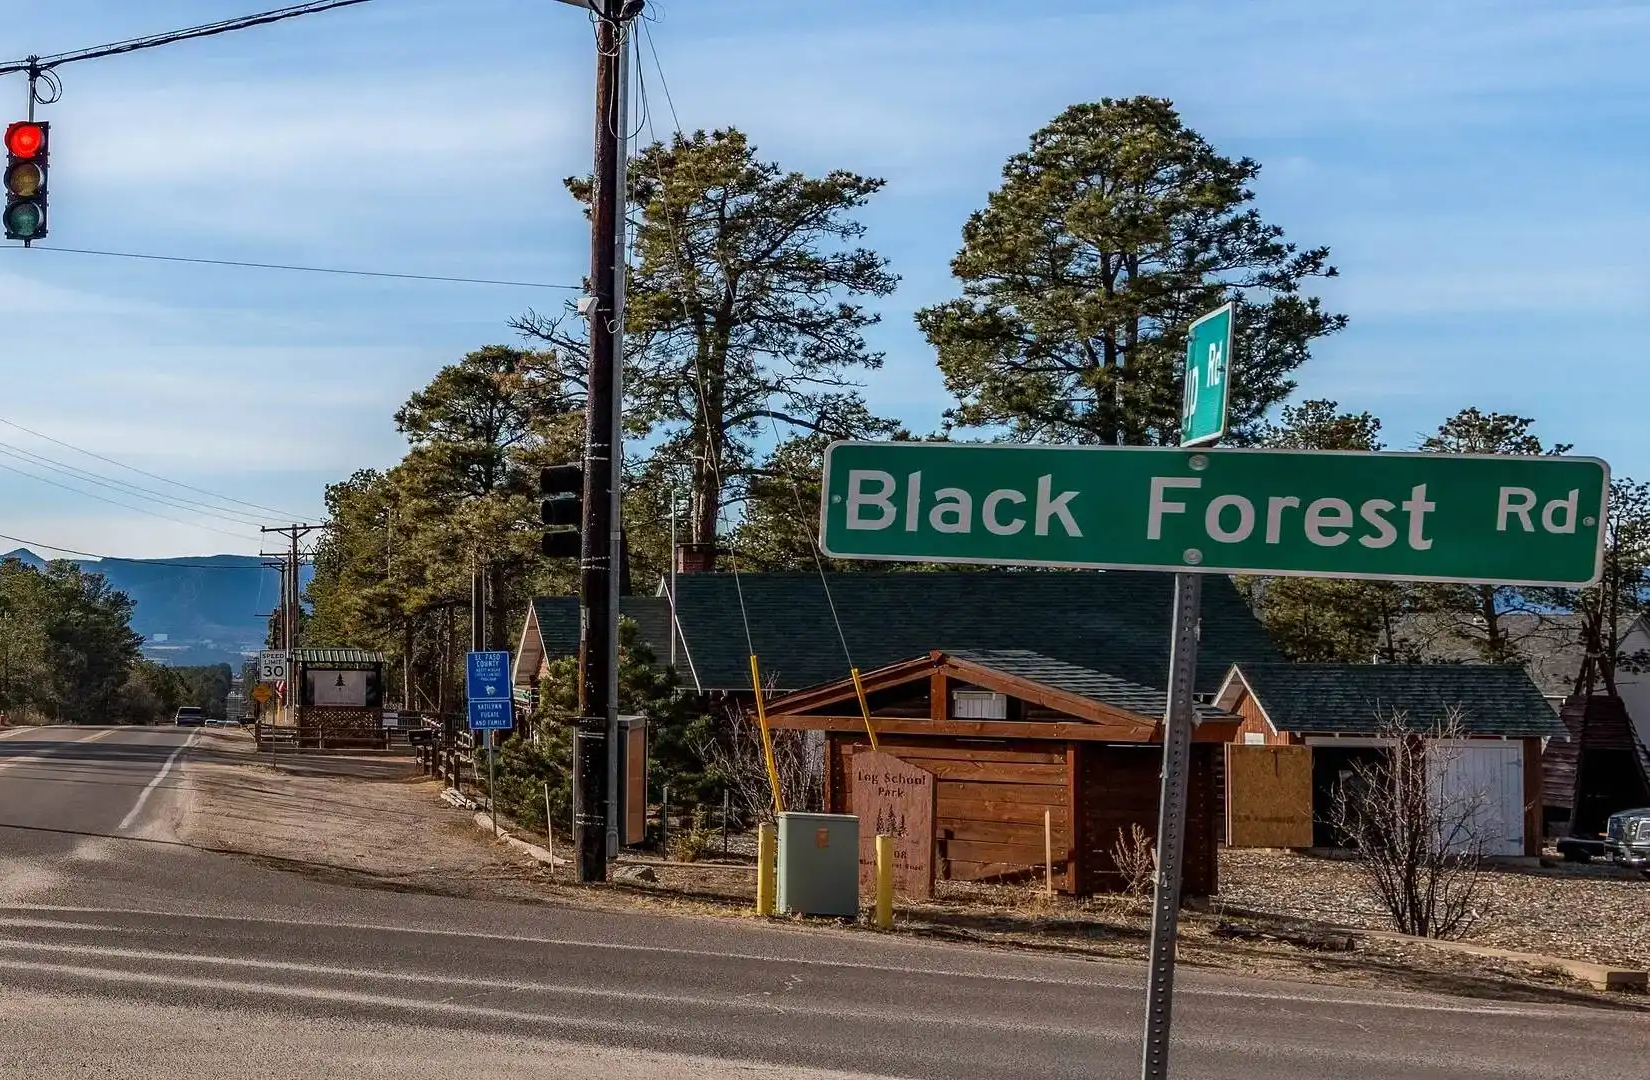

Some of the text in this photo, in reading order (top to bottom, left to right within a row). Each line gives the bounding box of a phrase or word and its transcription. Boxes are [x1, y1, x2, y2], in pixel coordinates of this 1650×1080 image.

[1207, 339, 1223, 389] Rd
[846, 469, 1579, 551] Black Forest Rd
[263, 665, 284, 677] 30
[858, 771, 926, 785] Log School
[878, 787, 906, 798] Park
[893, 850, 907, 860] 08
